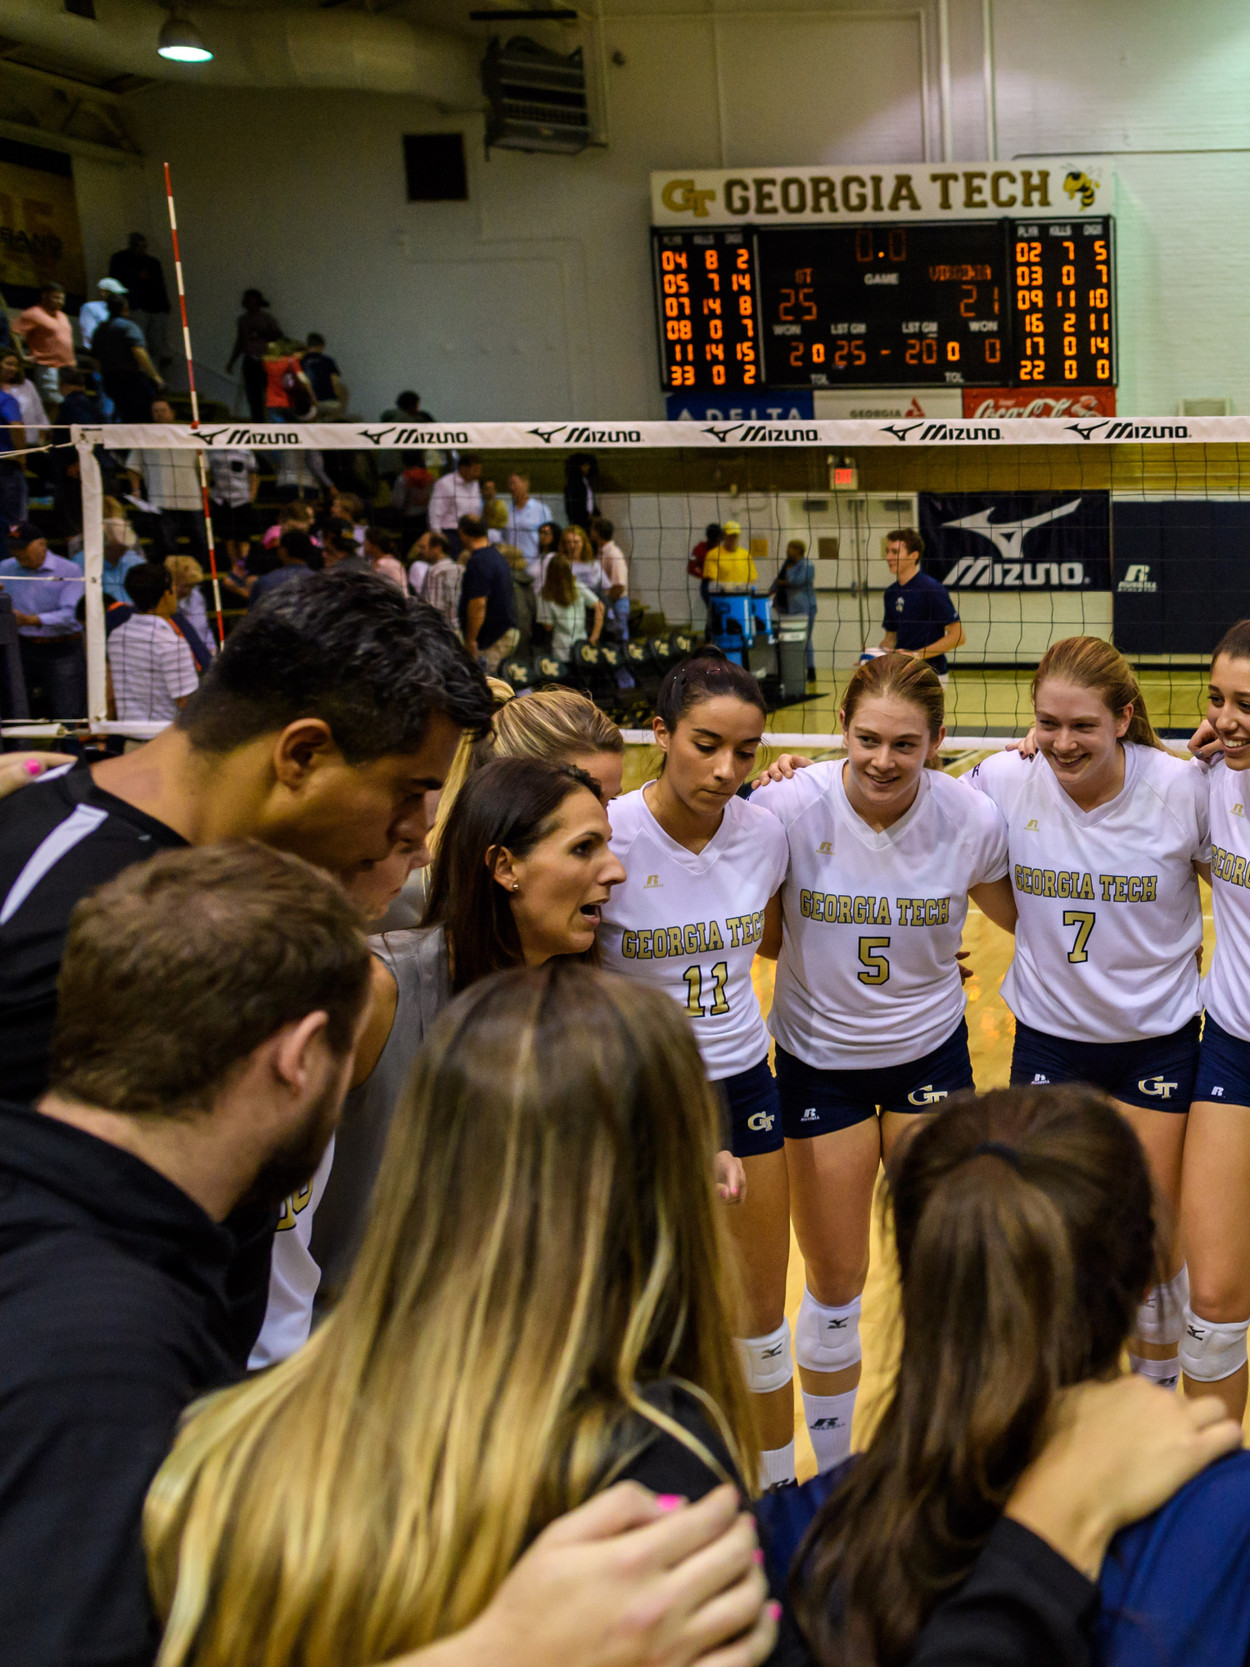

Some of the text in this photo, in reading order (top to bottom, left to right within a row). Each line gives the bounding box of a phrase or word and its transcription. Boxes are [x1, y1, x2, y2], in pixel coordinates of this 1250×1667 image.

[724, 170, 1052, 215] GEORGIA TECH
[662, 249, 749, 270] 04 8 2
[1016, 241, 1107, 263] 02 7 5
[663, 273, 751, 294] 05 7 14
[1016, 265, 1108, 286] 03 0 7
[665, 295, 752, 317] 07 14 8
[779, 288, 817, 321] 25
[960, 285, 999, 317] 21
[1017, 288, 1108, 310] 09 11 10
[666, 319, 754, 340] 08 0 7
[969, 321, 998, 332] WON
[1025, 313, 1109, 333] 16 2 11
[675, 342, 755, 362] 11 14 15
[790, 342, 804, 367] 2
[812, 343, 825, 363] 0
[834, 340, 866, 366] 25
[905, 339, 937, 364] 20
[947, 341, 960, 361] 0
[985, 339, 1000, 363] 0
[1026, 336, 1109, 356] 17 0 14
[671, 364, 756, 386] 33 0 2
[1019, 359, 1110, 380] 22 0 0
[942, 556, 1084, 586] MIZUNO
[1014, 864, 1157, 902] GEORGIA TECH
[800, 888, 951, 926] GEORGIA TECH
[622, 920, 724, 959] GEORGIA
[1063, 910, 1096, 963] 7
[857, 936, 891, 985] 5
[683, 961, 730, 1017] 11
